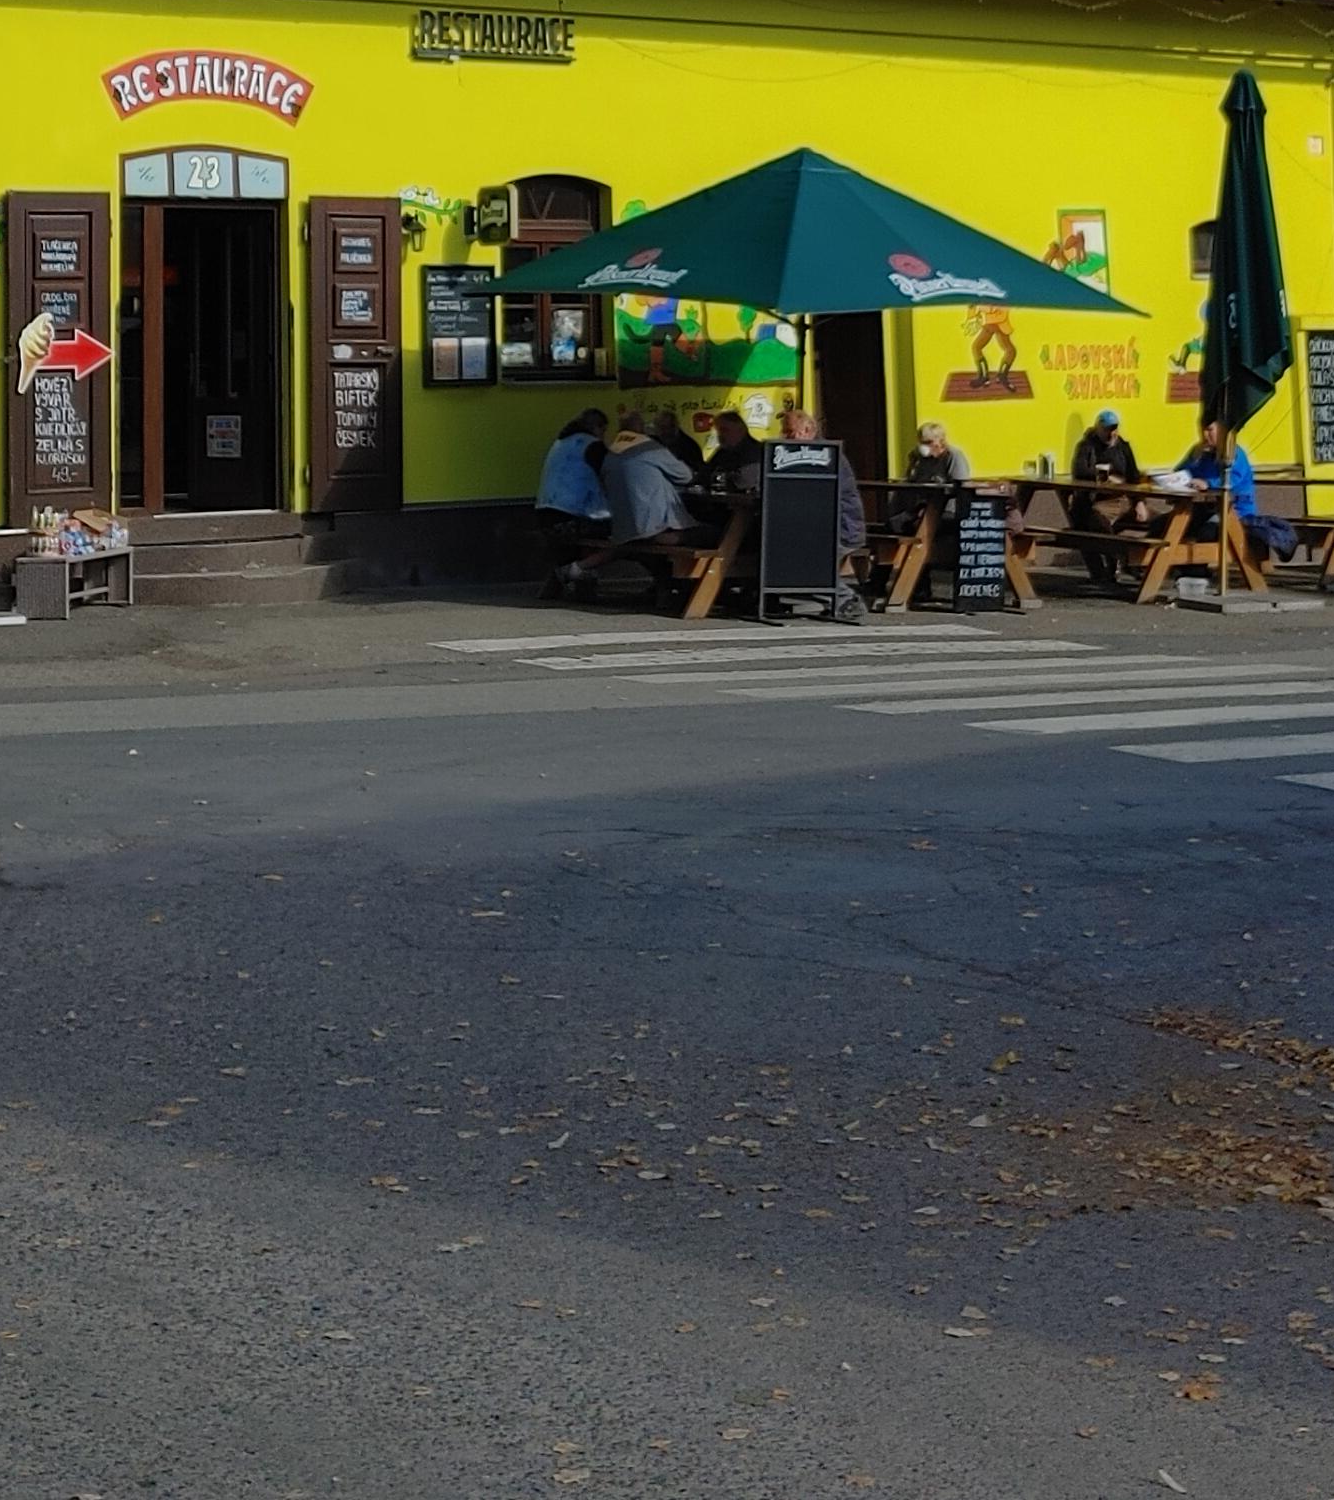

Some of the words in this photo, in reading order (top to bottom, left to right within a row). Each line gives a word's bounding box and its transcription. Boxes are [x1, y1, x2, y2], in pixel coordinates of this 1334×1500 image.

[419, 9, 575, 52] RESTAURACE
[110, 52, 305, 117] RESTAURACE
[186, 155, 221, 190] 23
[1040, 335, 1140, 371] LADOVSKÁ
[335, 389, 378, 408] BIFTEK
